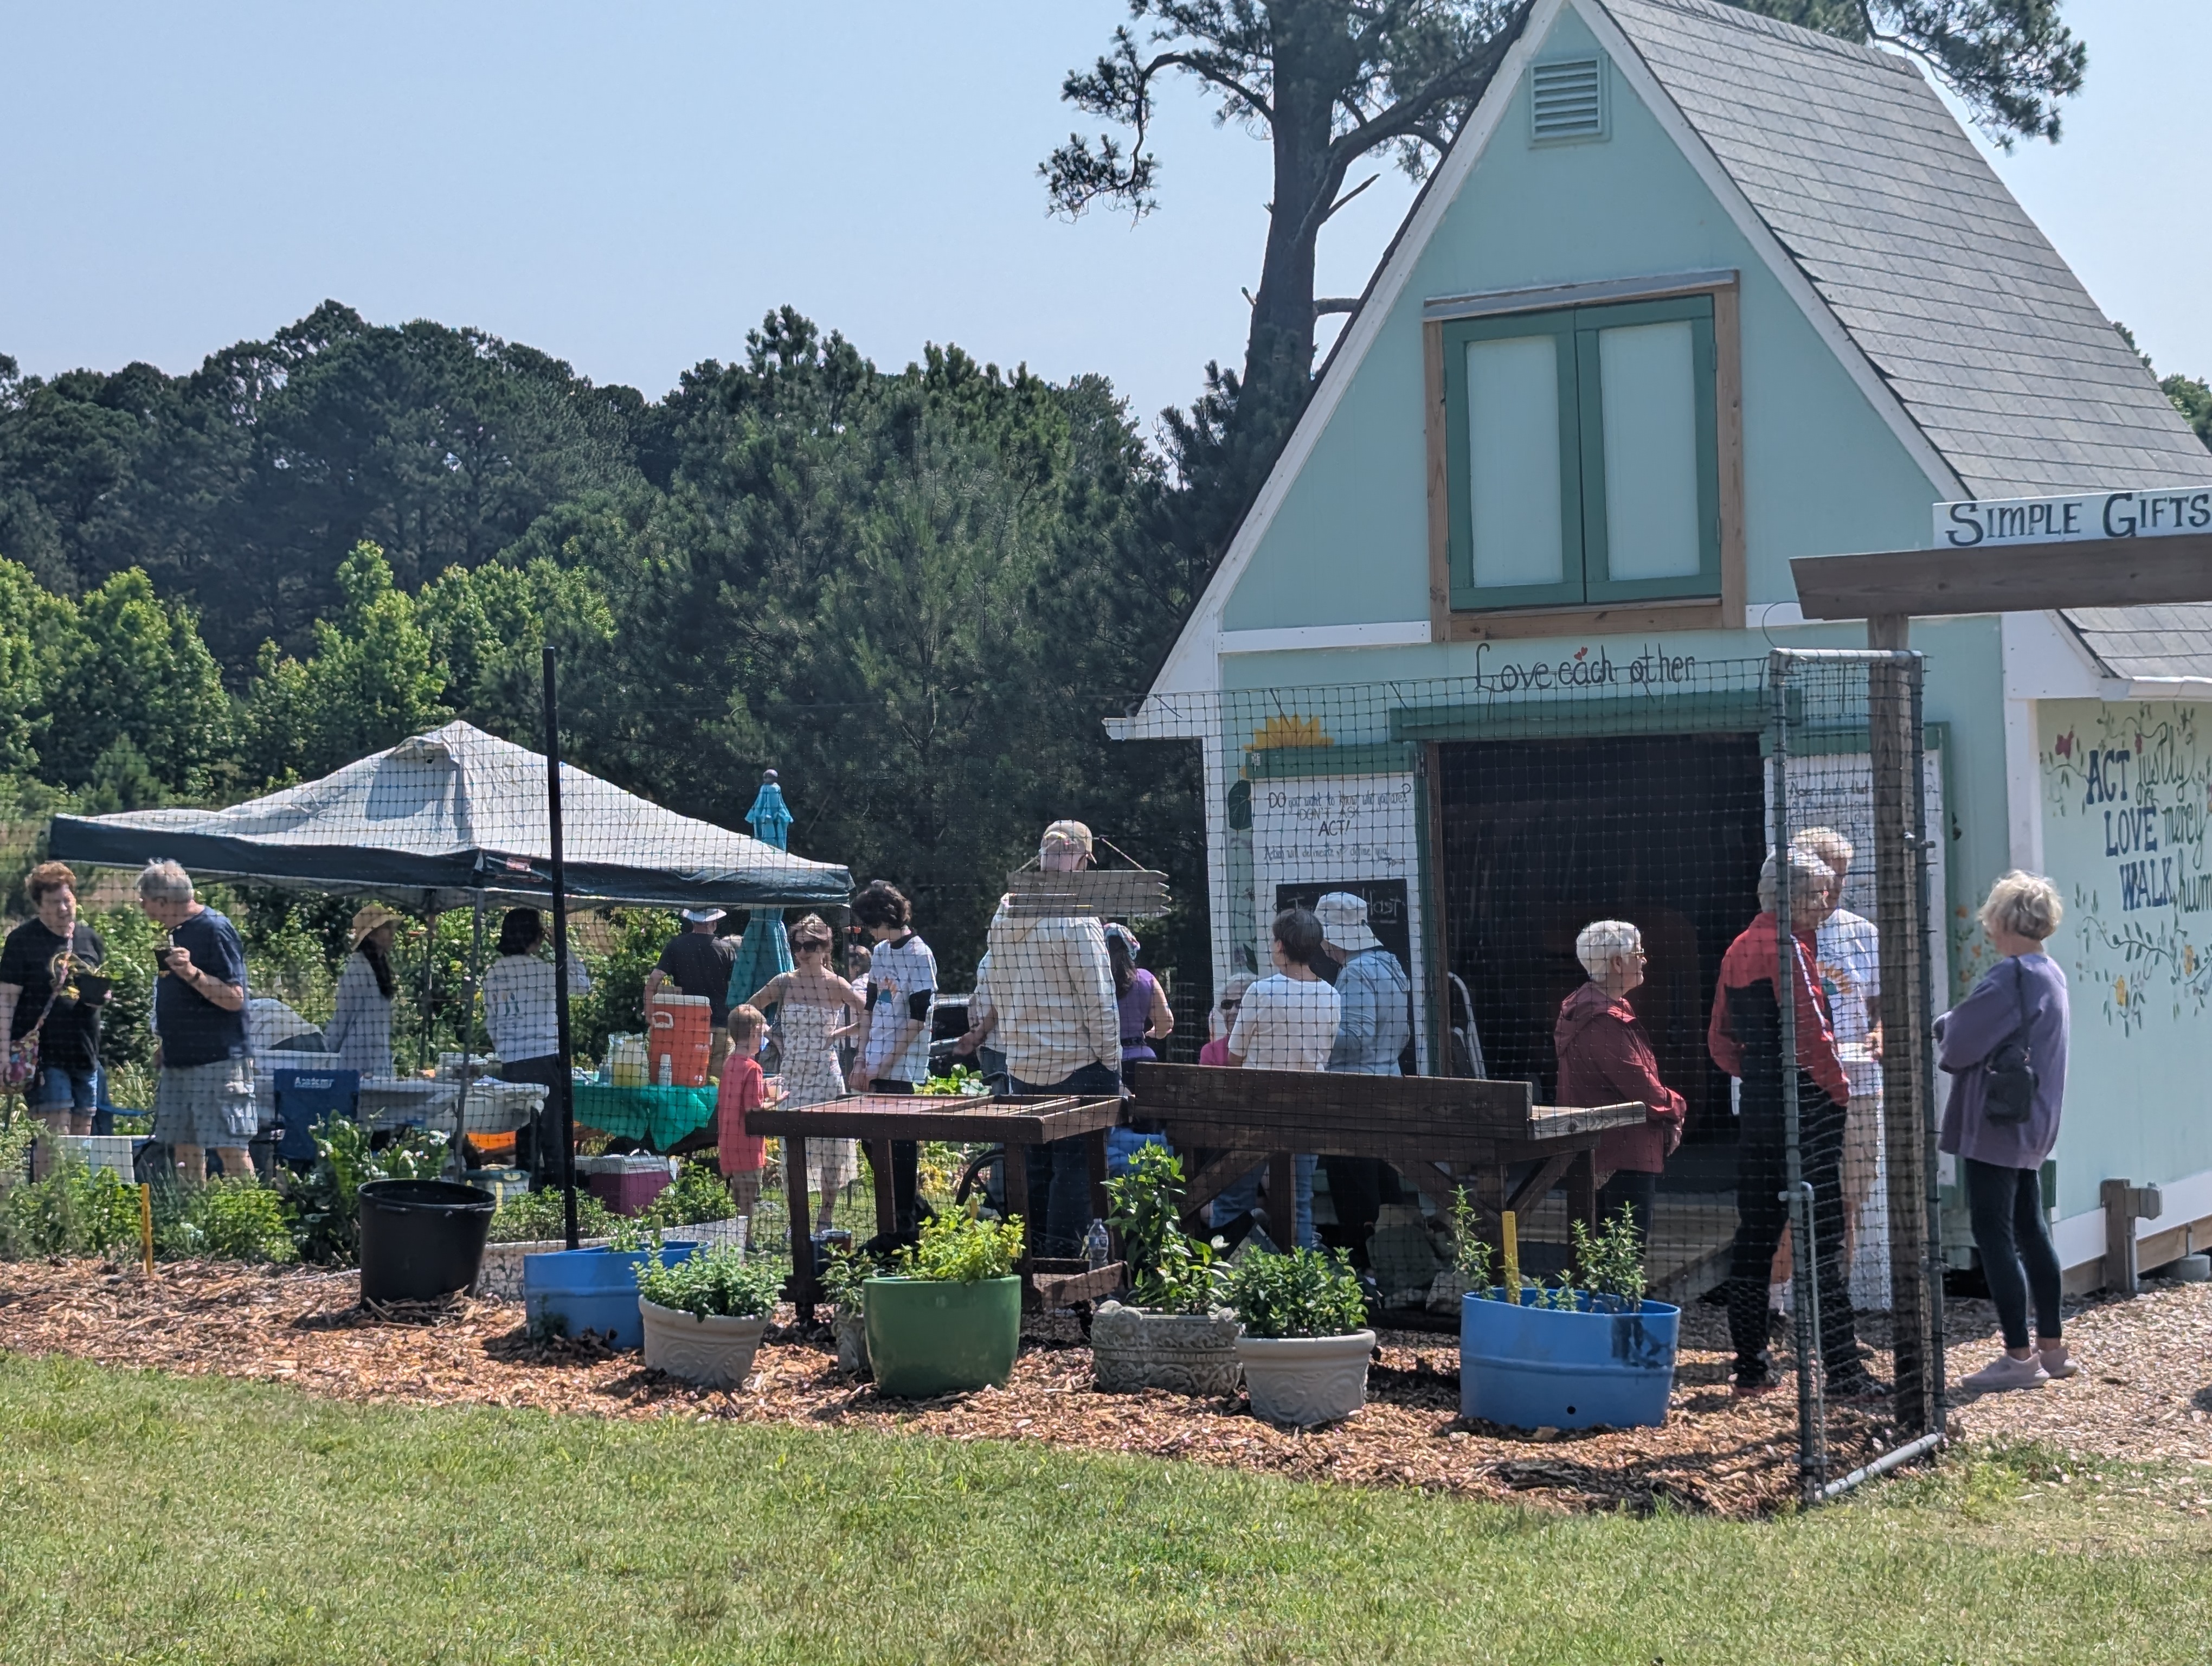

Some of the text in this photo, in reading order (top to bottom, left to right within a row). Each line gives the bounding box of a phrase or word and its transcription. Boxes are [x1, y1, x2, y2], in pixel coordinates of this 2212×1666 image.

[1945, 492, 2211, 547] SIMPLE GIFTS
[1474, 643, 1695, 693] Love each other
[2086, 725, 2194, 806] ACT justly
[1269, 792, 1287, 808] DO
[1327, 792, 1335, 806] to
[1318, 819, 1351, 836] ACT!
[2103, 802, 2203, 870] LOVE mercy
[2119, 856, 2173, 912] WALK
